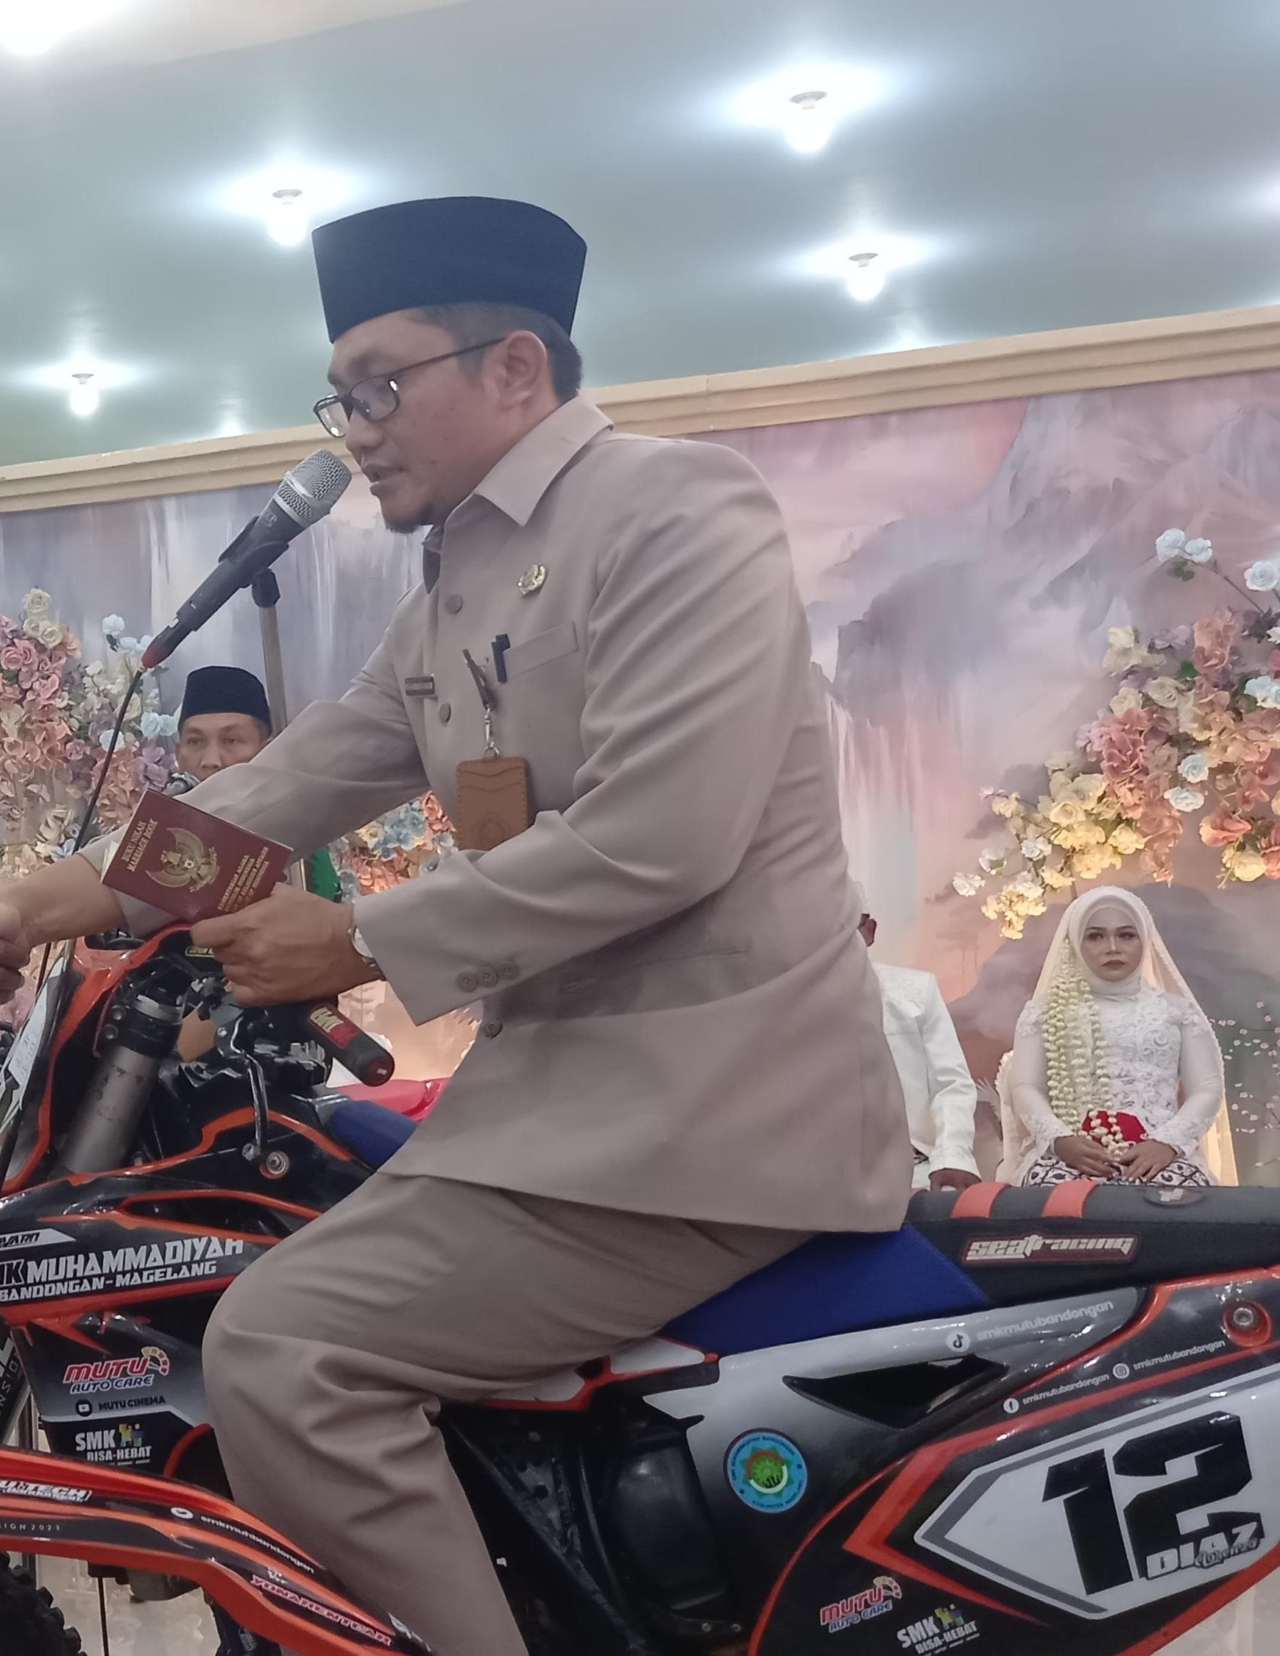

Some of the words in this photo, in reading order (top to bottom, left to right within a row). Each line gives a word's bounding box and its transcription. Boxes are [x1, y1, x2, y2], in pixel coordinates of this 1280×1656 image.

[127, 837, 149, 873] MARRIAGE
[143, 818, 158, 839] BOOK
[131, 821, 147, 844] NIKAH
[26, 1236, 244, 1284] MUHAMMADIYAH
[976, 1300, 1114, 1342] smkmutubandongan
[63, 1357, 151, 1384] MUTU
[70, 1379, 112, 1394] AUTO
[112, 1374, 155, 1389] CARE
[98, 1400, 127, 1411] MUTU
[128, 1395, 166, 1408] CINEMA
[75, 1429, 117, 1452] SMK
[1042, 1411, 1265, 1596] 12
[1145, 1521, 1259, 1581] DIAZ
[820, 1585, 885, 1626] MUTU
[828, 1613, 862, 1634] AUTO
[861, 1599, 894, 1620] CARE
[896, 1615, 941, 1649] SMK
